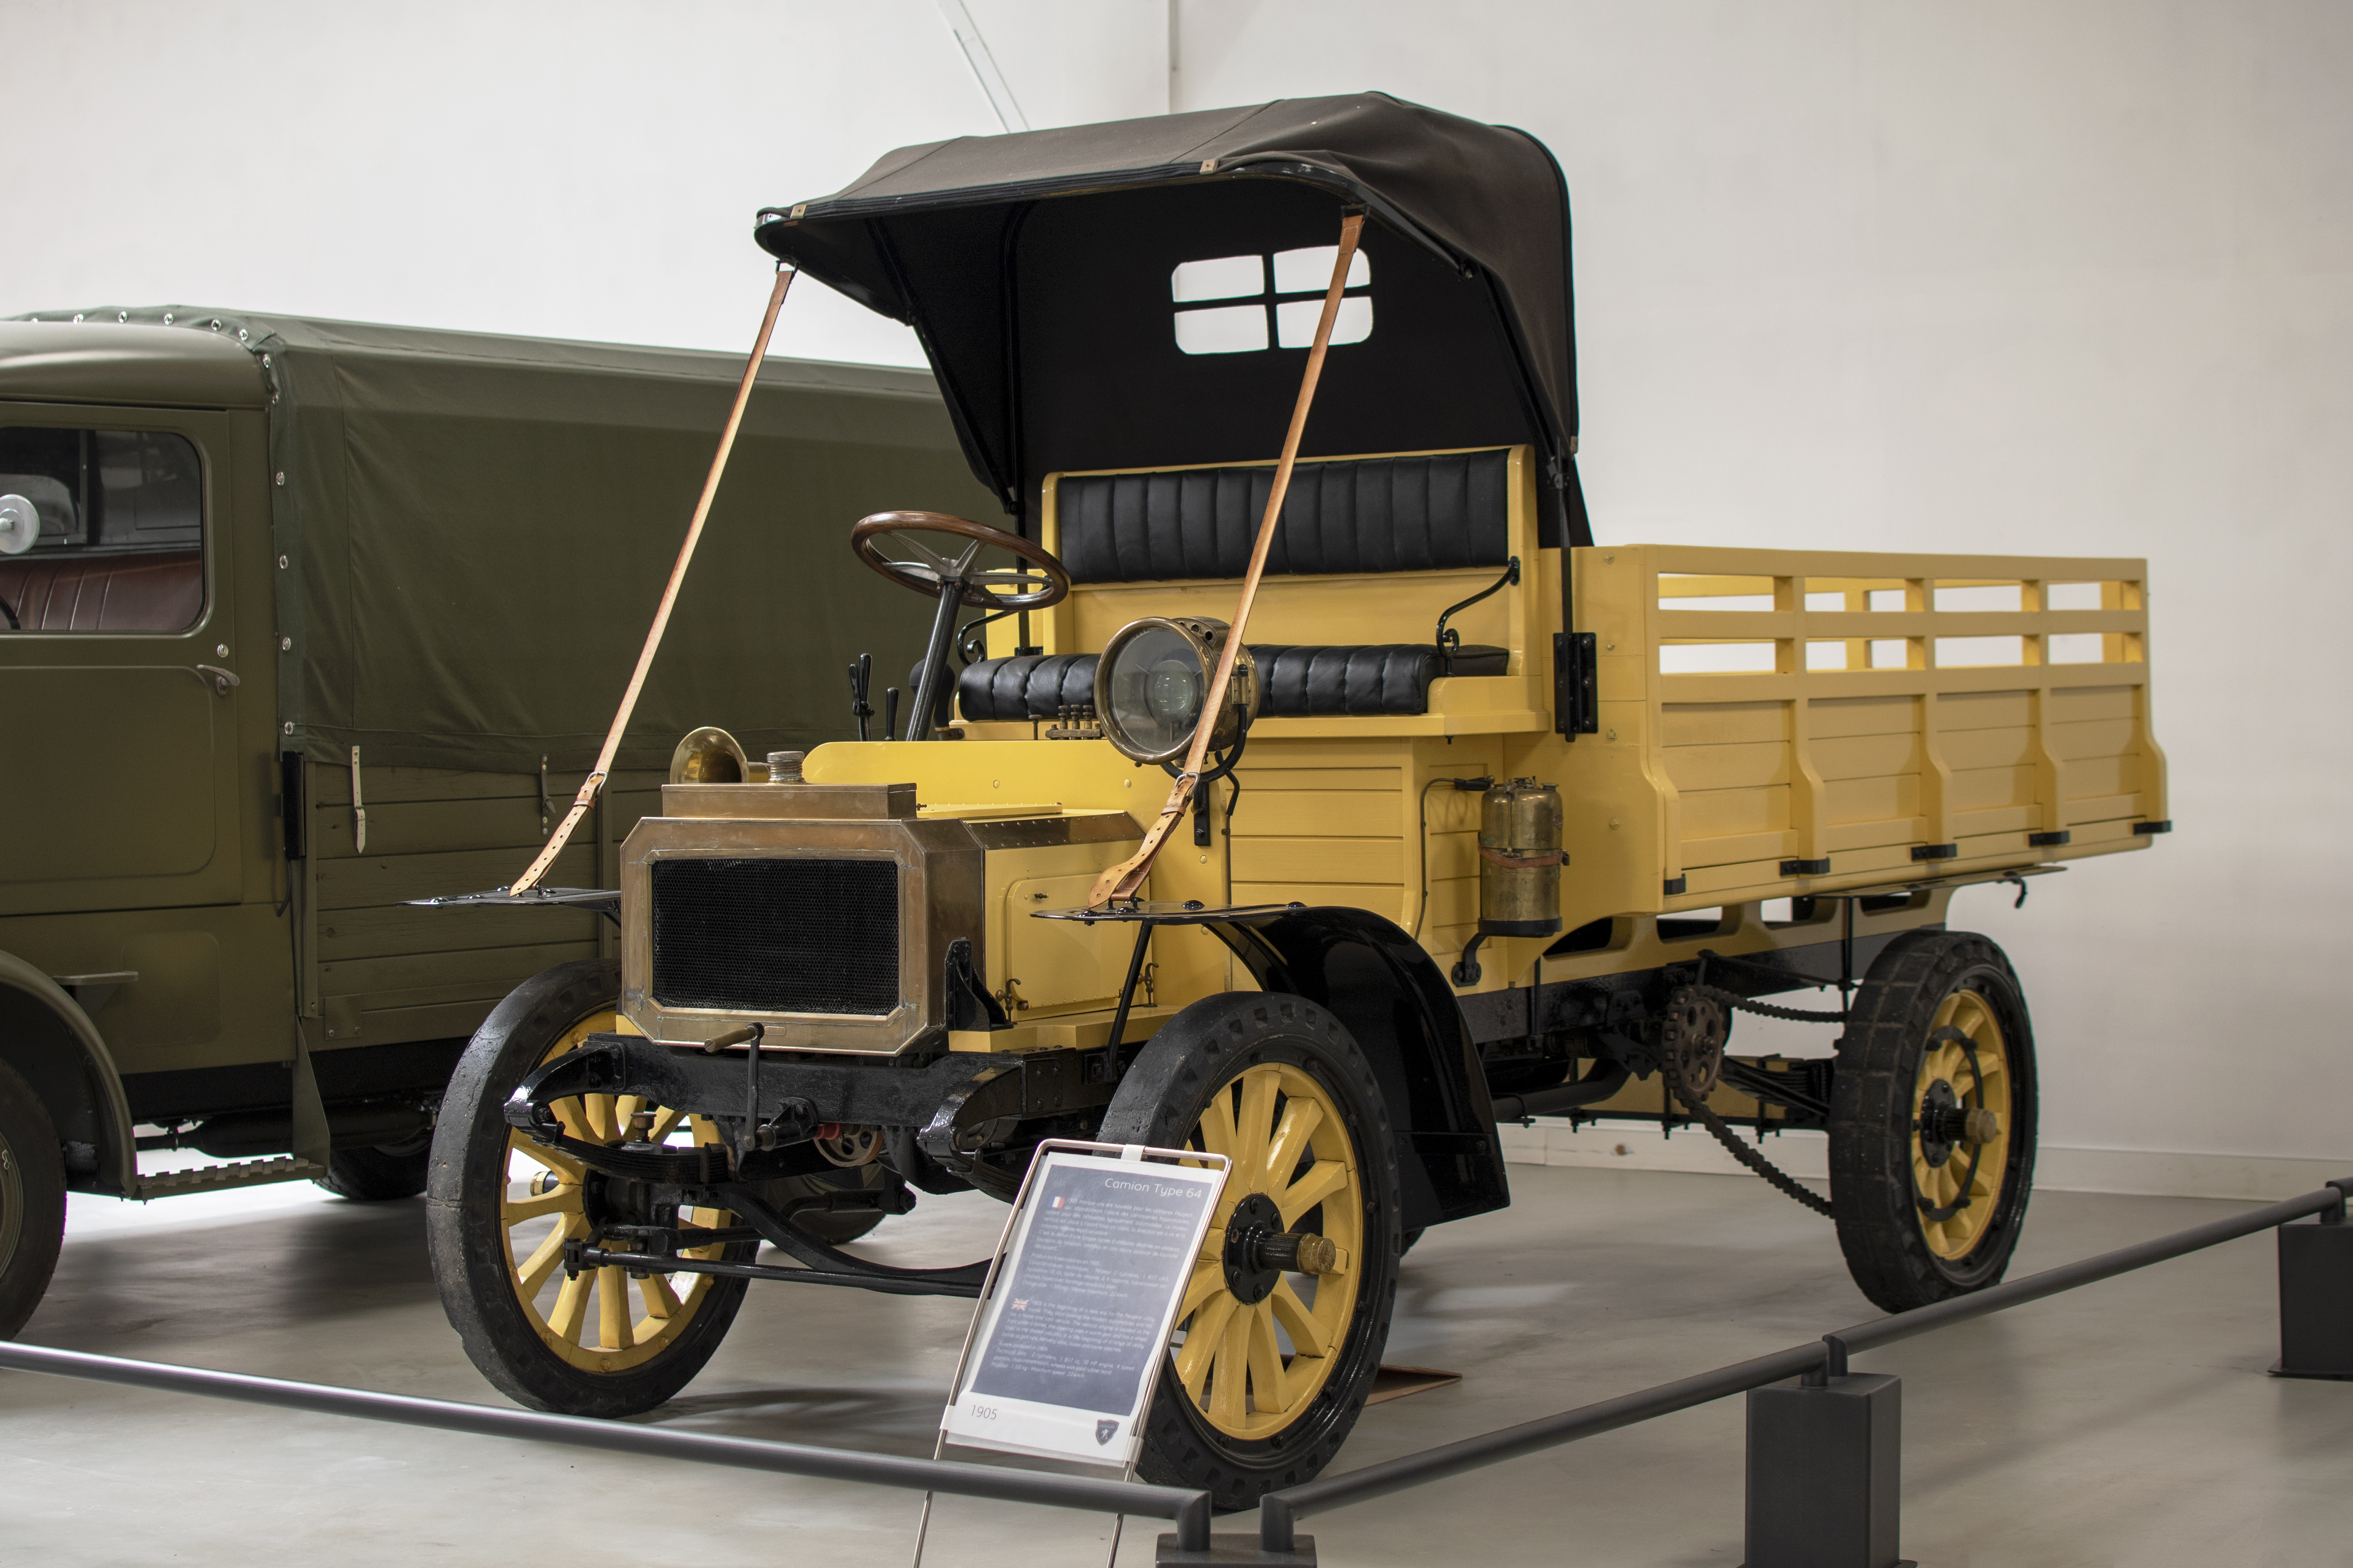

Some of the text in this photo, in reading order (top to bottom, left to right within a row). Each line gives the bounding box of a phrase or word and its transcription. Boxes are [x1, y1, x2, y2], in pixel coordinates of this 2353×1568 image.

[1105, 1178, 1202, 1199] Camion Type 64
[972, 1405, 998, 1420] 1905
